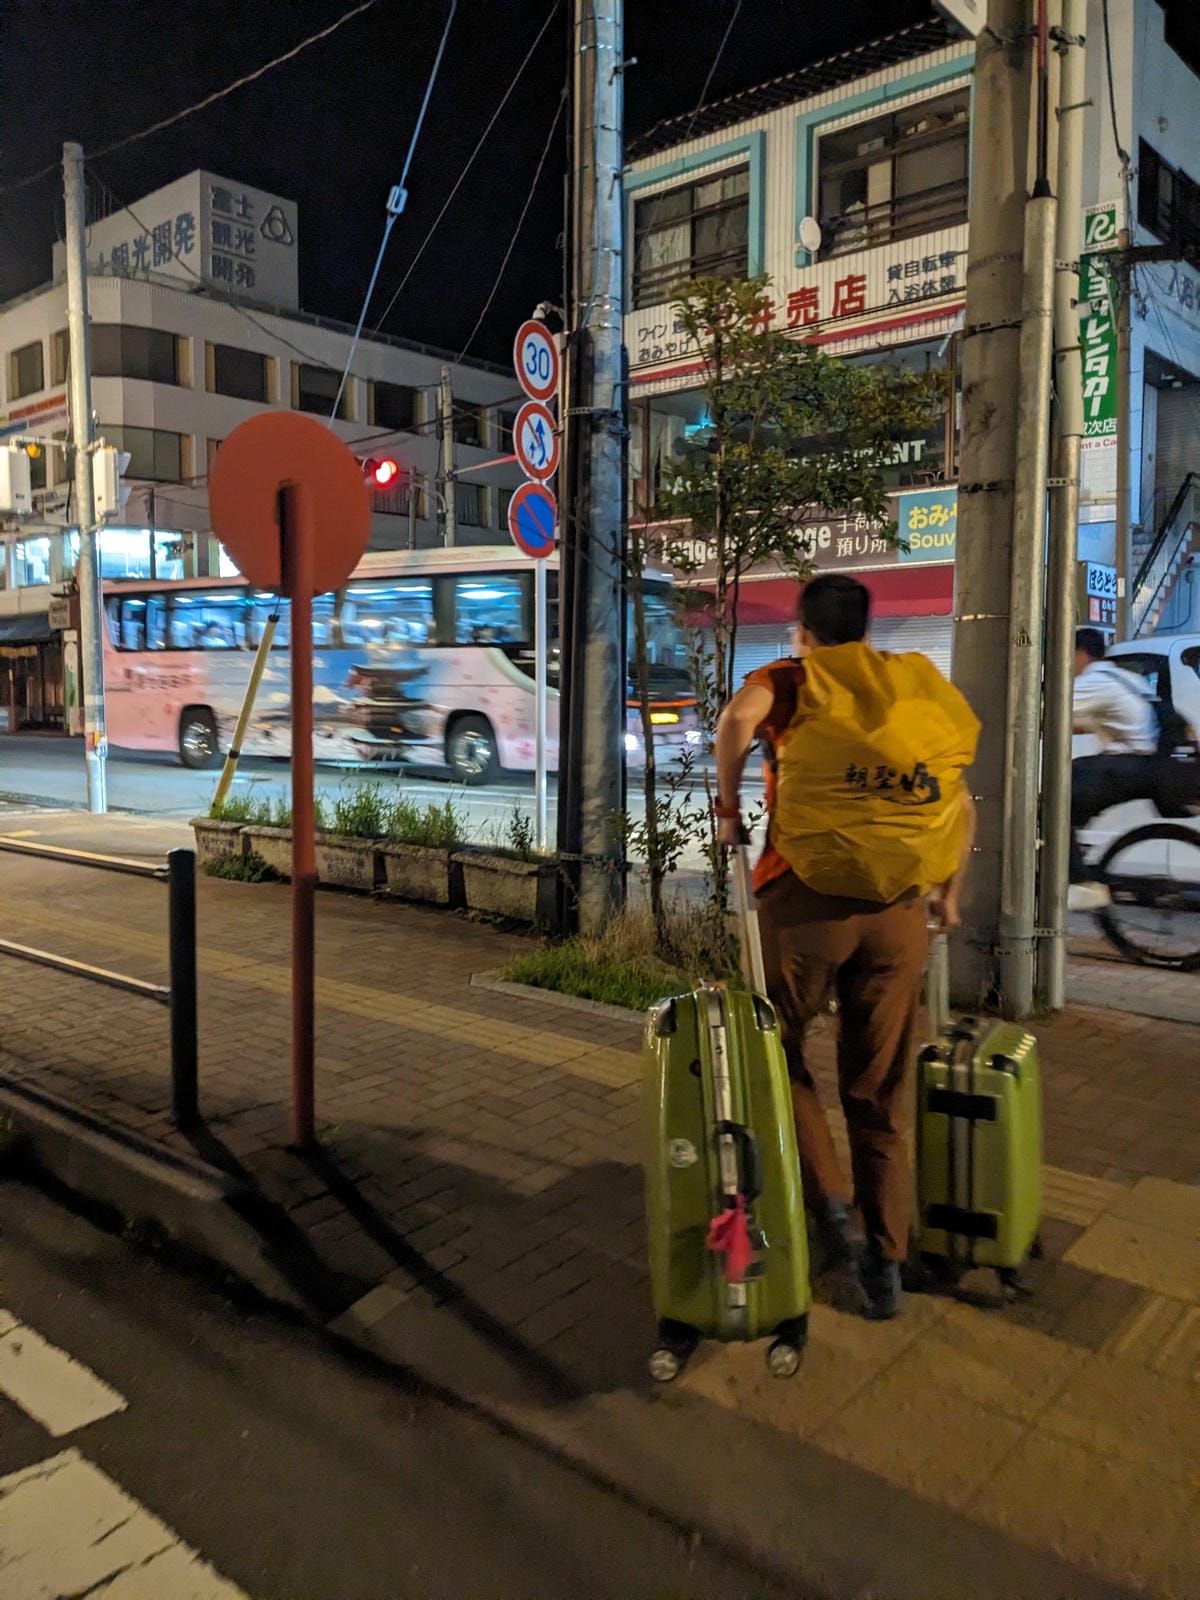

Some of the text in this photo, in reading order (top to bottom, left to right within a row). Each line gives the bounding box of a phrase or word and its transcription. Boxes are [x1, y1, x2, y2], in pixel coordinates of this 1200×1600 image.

[1086, 203, 1116, 214] TOYOTA
[887, 251, 957, 282] 貸自転車
[638, 324, 668, 342] ワイン
[526, 342, 549, 381] 30
[836, 535, 887, 558] 預り所
